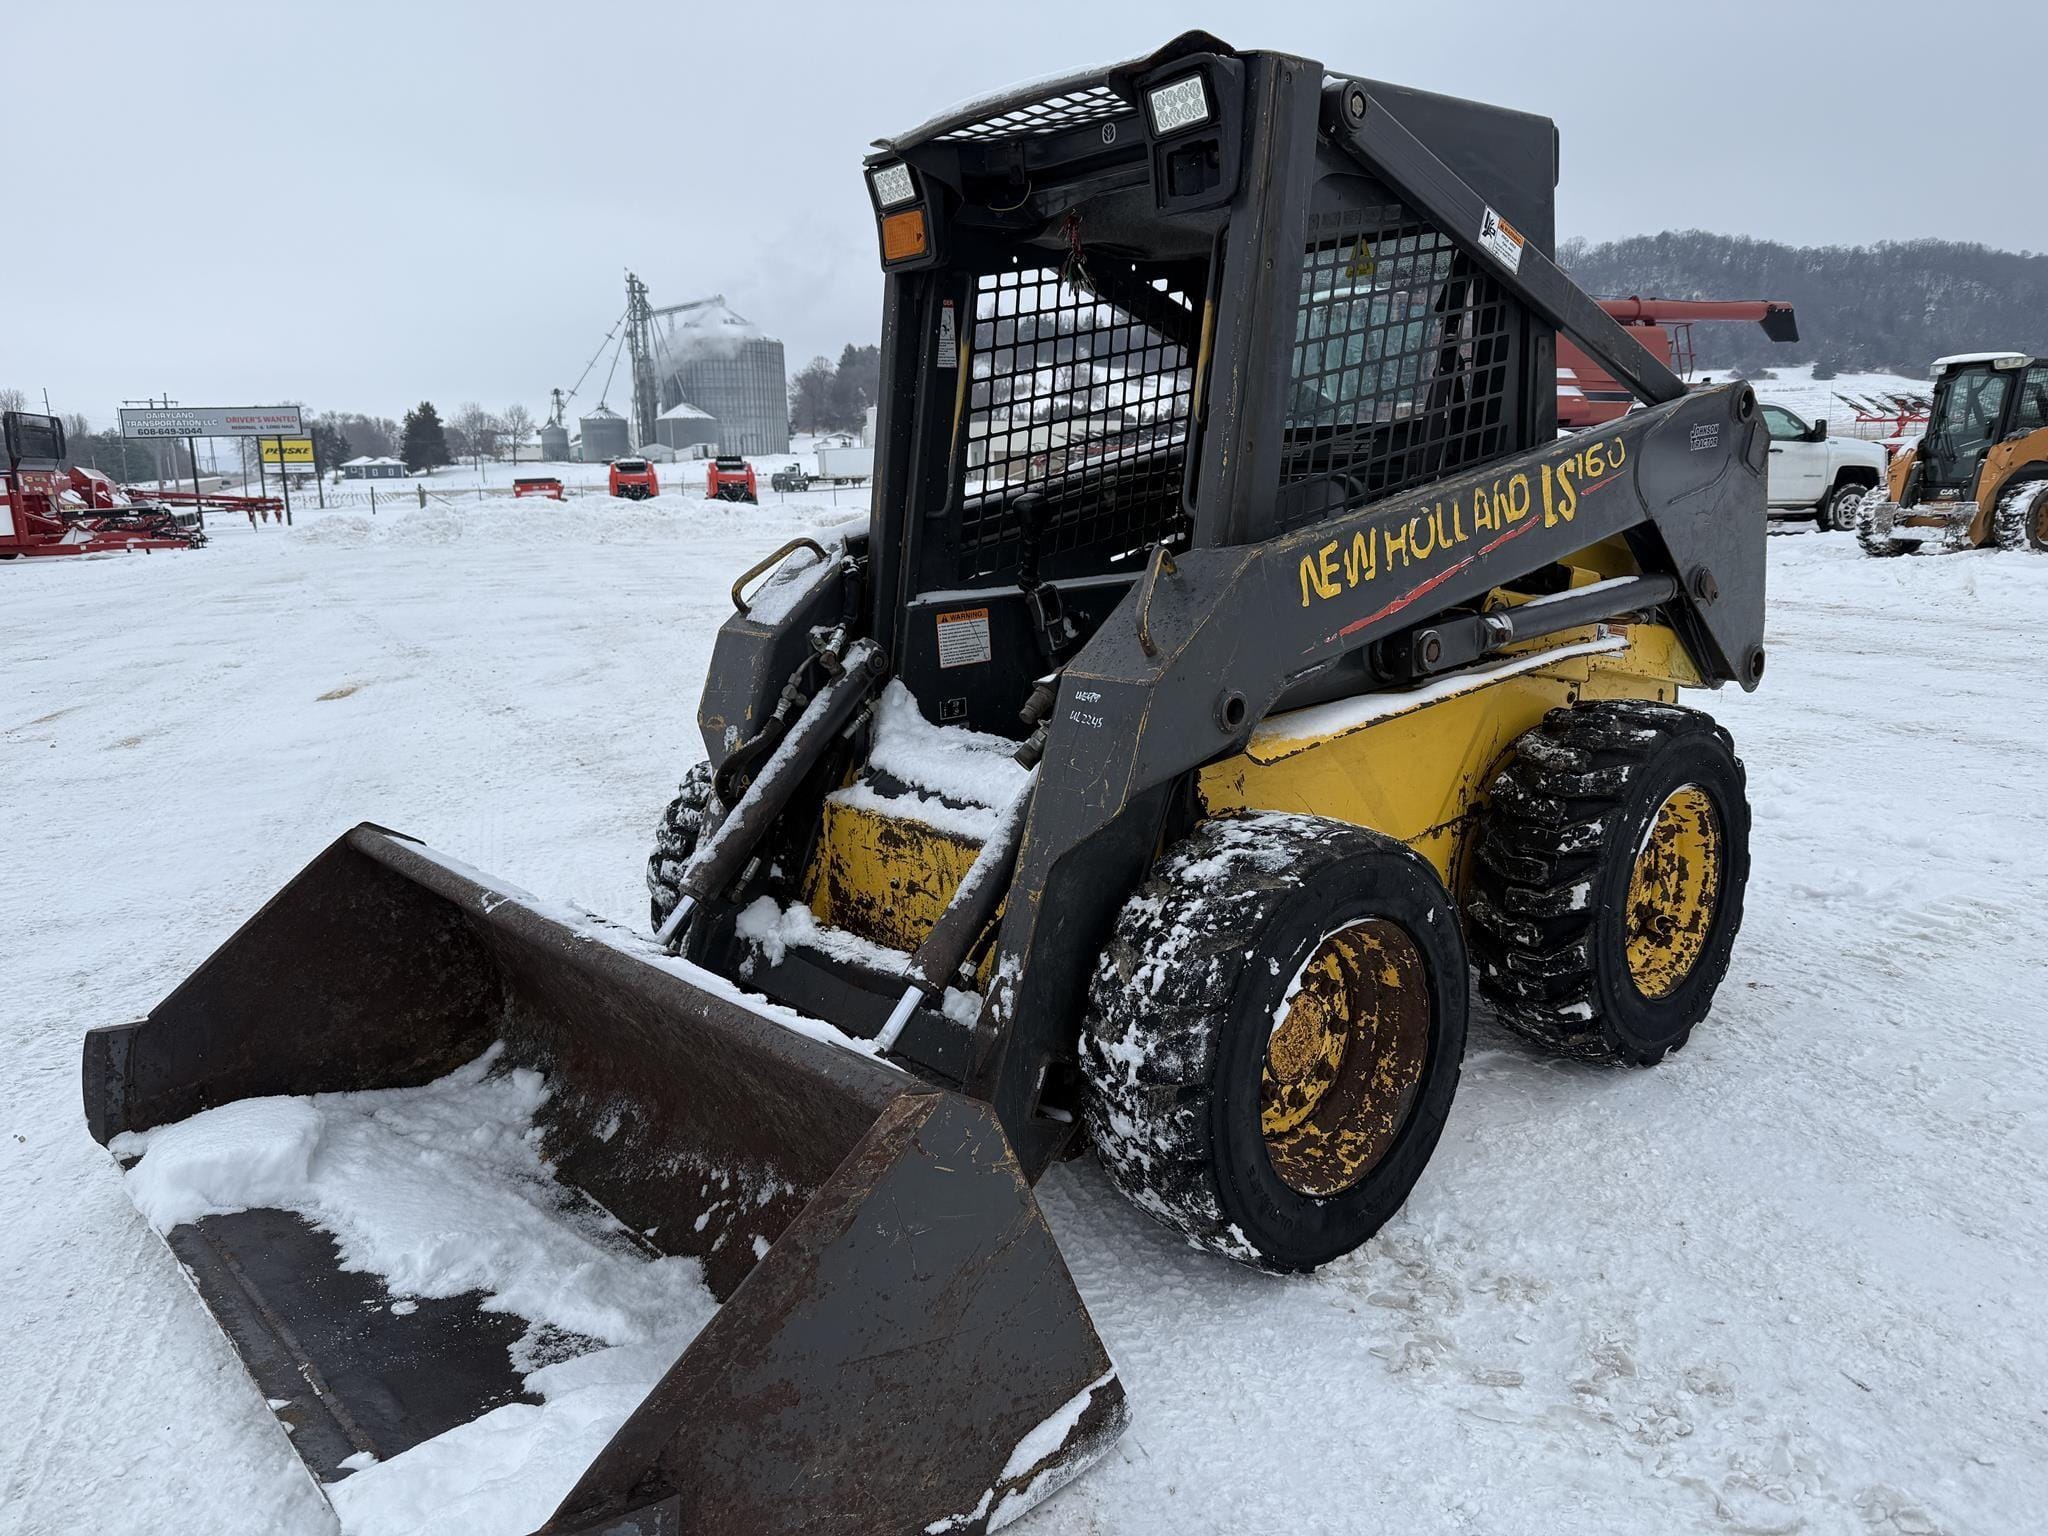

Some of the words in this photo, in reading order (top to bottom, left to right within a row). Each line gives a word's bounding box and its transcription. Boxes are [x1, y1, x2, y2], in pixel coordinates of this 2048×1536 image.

[225, 416, 263, 424] DRIVER'S
[263, 415, 298, 423] WANTED
[137, 427, 203, 436] 608-649-3044
[1690, 436, 1719, 451] TRACTOR
[1299, 527, 1377, 607] NEW
[949, 610, 983, 622] WARNING
